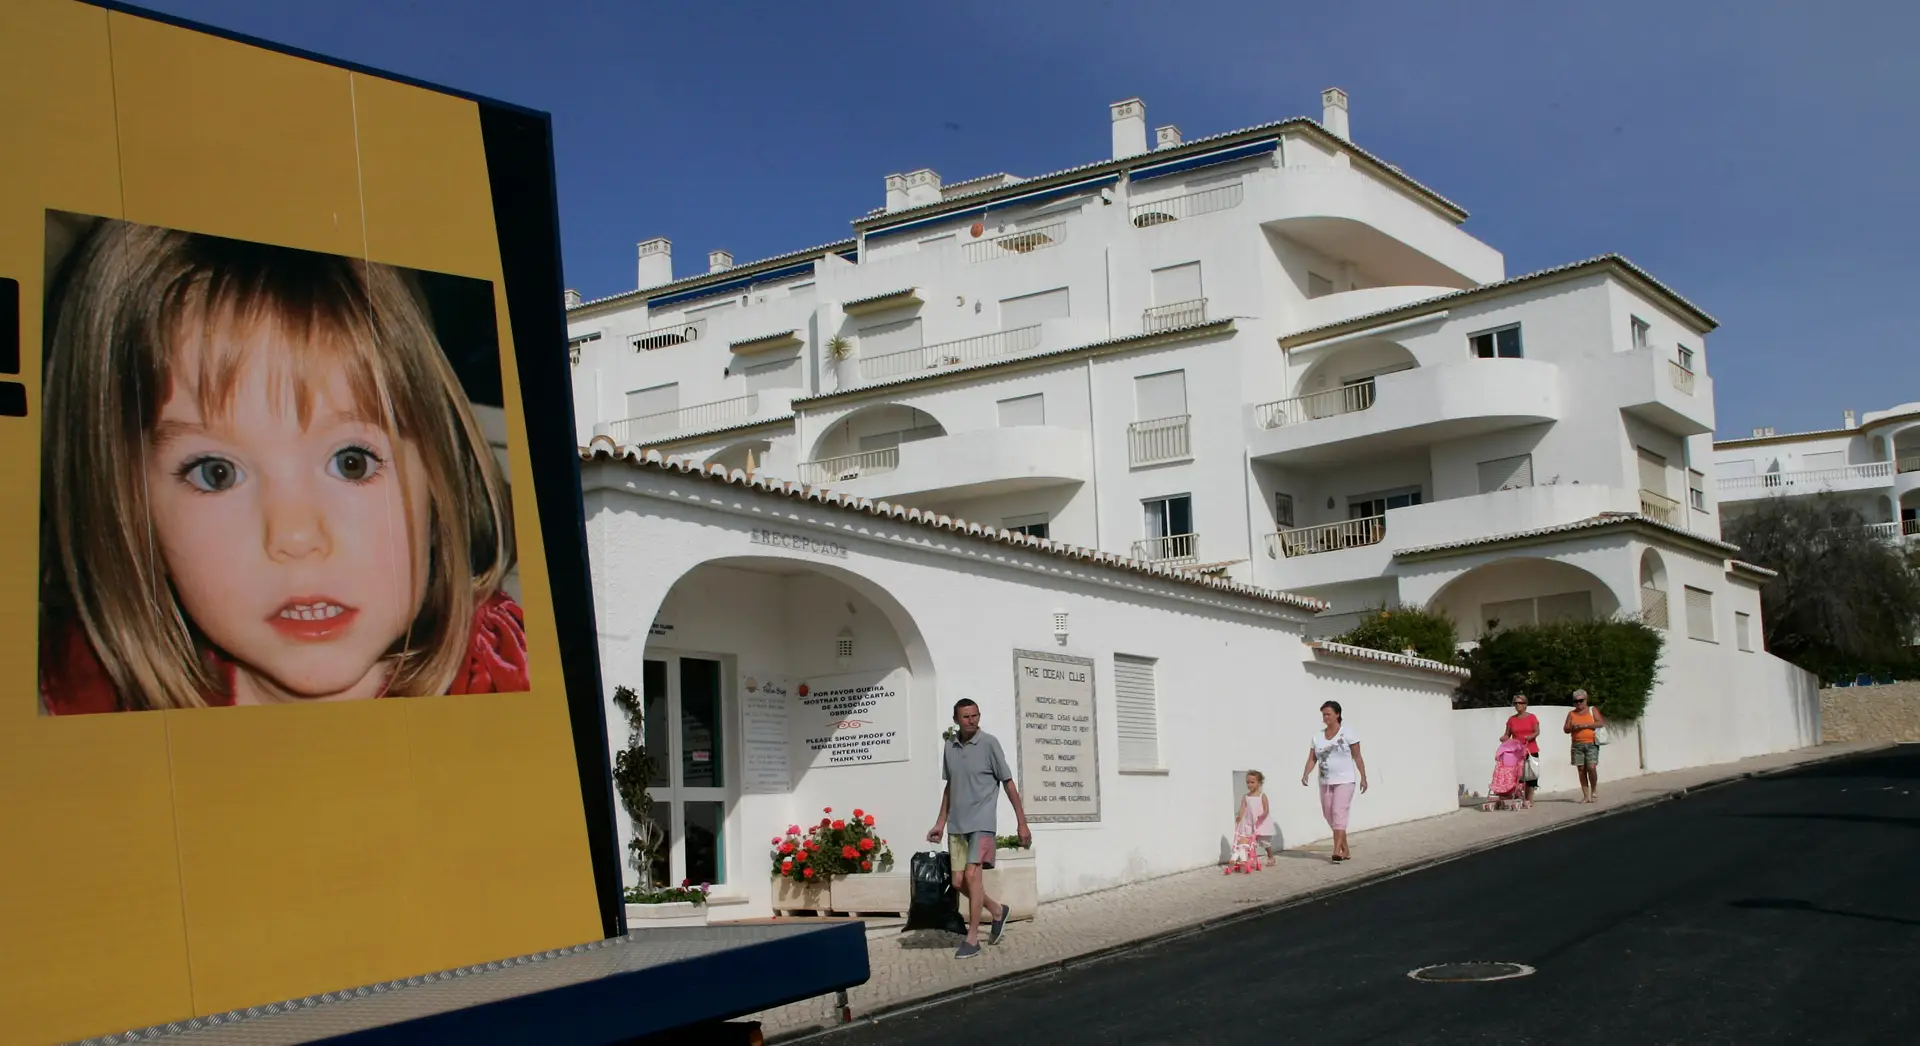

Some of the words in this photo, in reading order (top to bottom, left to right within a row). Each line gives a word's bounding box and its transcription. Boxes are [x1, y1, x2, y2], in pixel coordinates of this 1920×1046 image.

[1025, 666, 1039, 677] THE
[1043, 669, 1064, 680] OCEAN
[1069, 672, 1085, 682] CLUB
[856, 686, 884, 694] QUEIRA
[804, 697, 838, 705] MOSTRAR
[833, 700, 877, 709] ASSOCIADO
[830, 708, 868, 716] OBRIGADO
[811, 742, 859, 750] MEMBERSHIP
